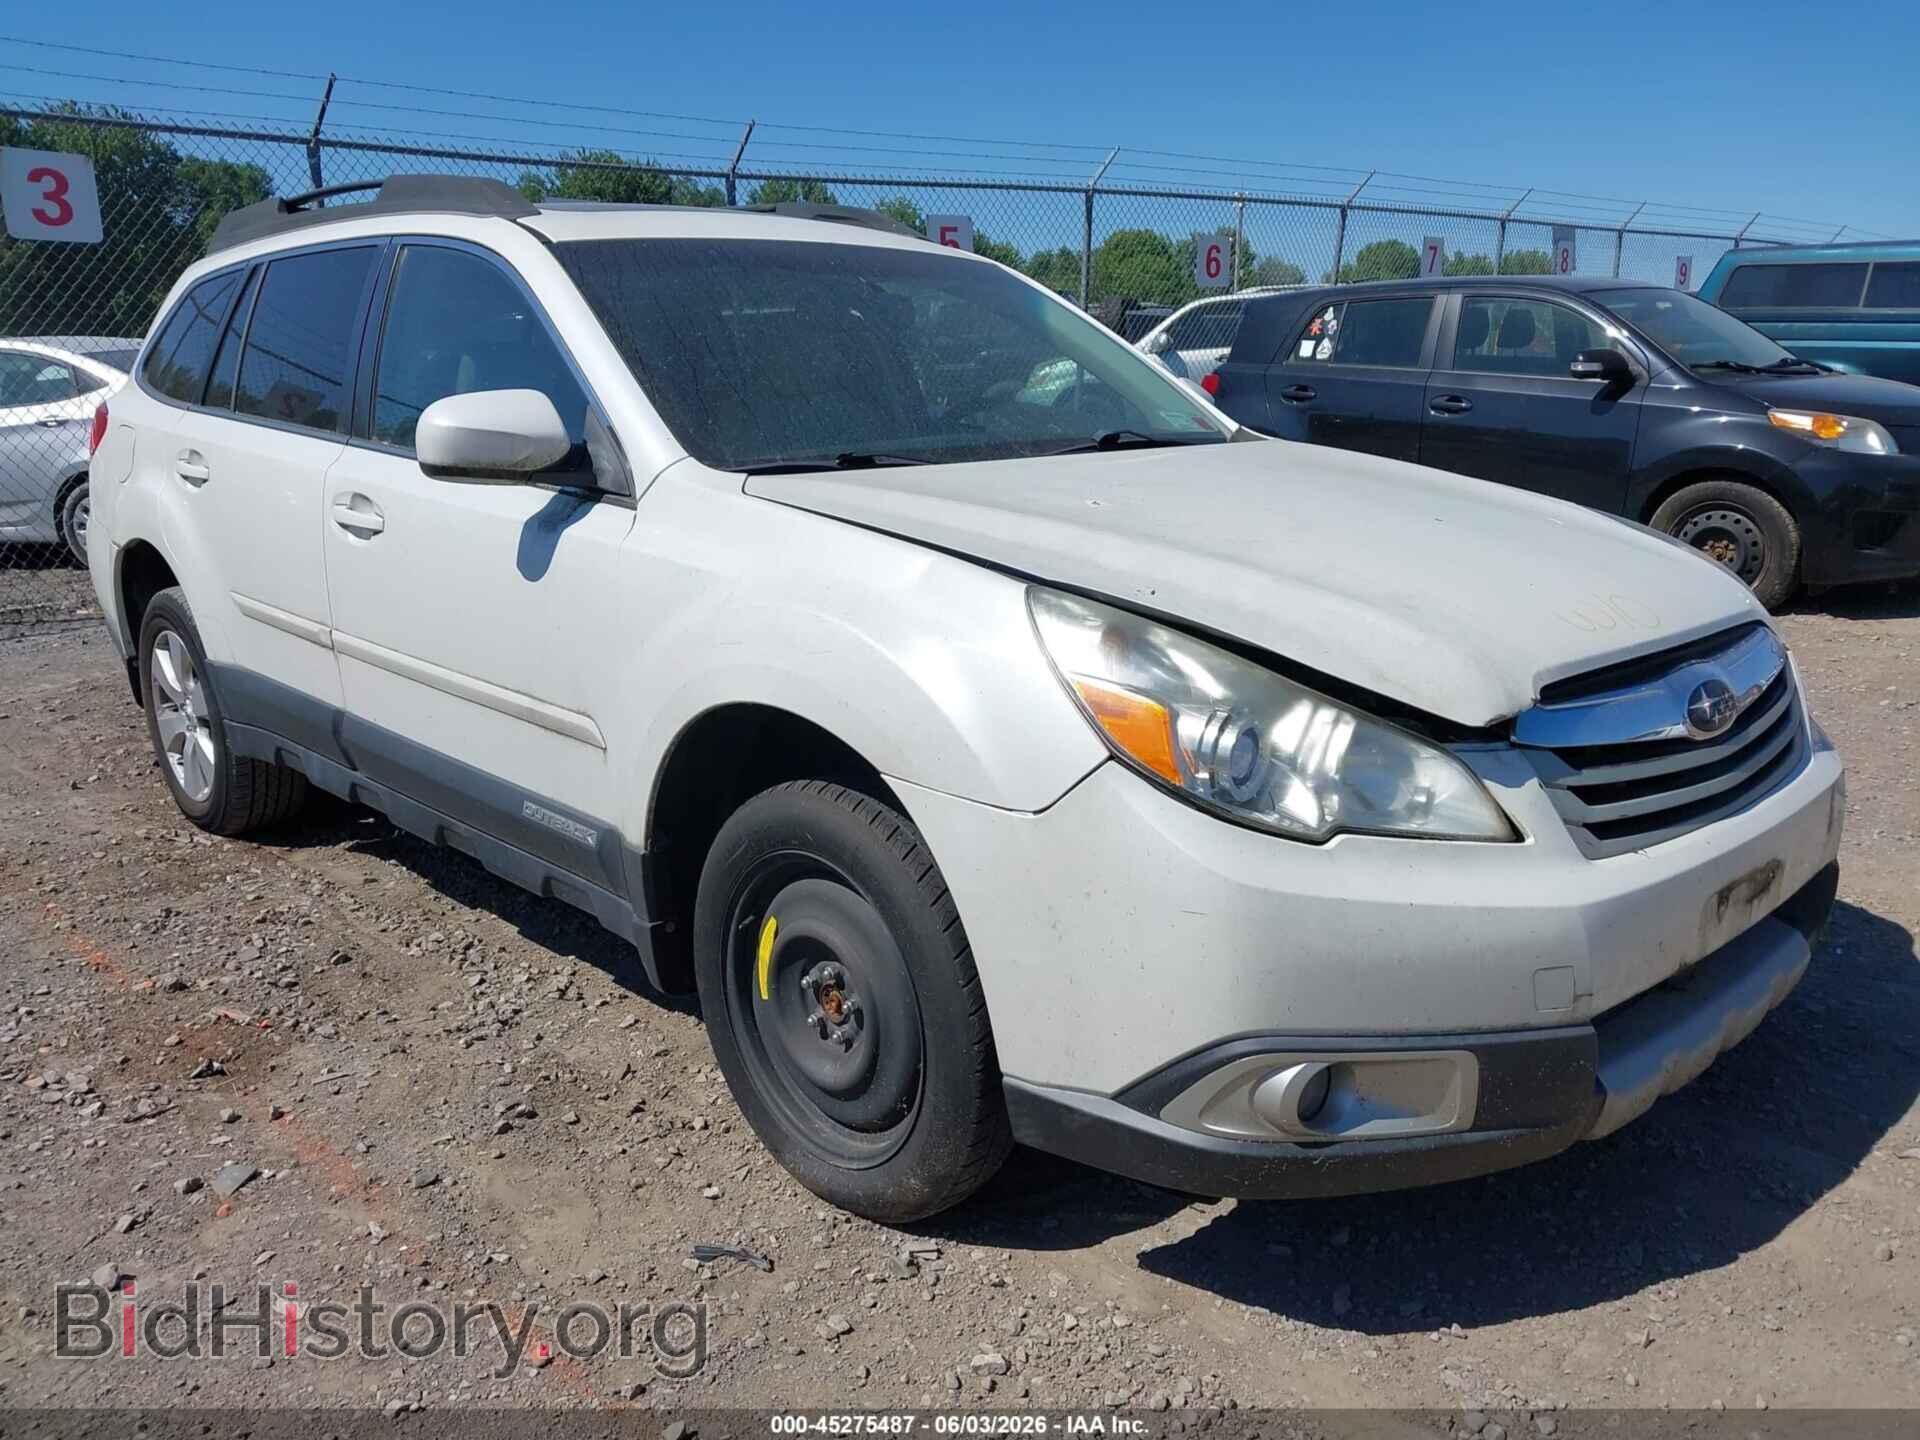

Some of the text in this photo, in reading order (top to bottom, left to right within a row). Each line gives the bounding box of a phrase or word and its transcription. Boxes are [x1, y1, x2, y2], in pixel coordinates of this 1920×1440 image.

[27, 167, 73, 226] 3
[940, 226, 960, 249] 5
[1206, 244, 1221, 278] 6
[1428, 245, 1438, 273] 7
[1561, 248, 1569, 273] 8
[1680, 263, 1687, 285] 9
